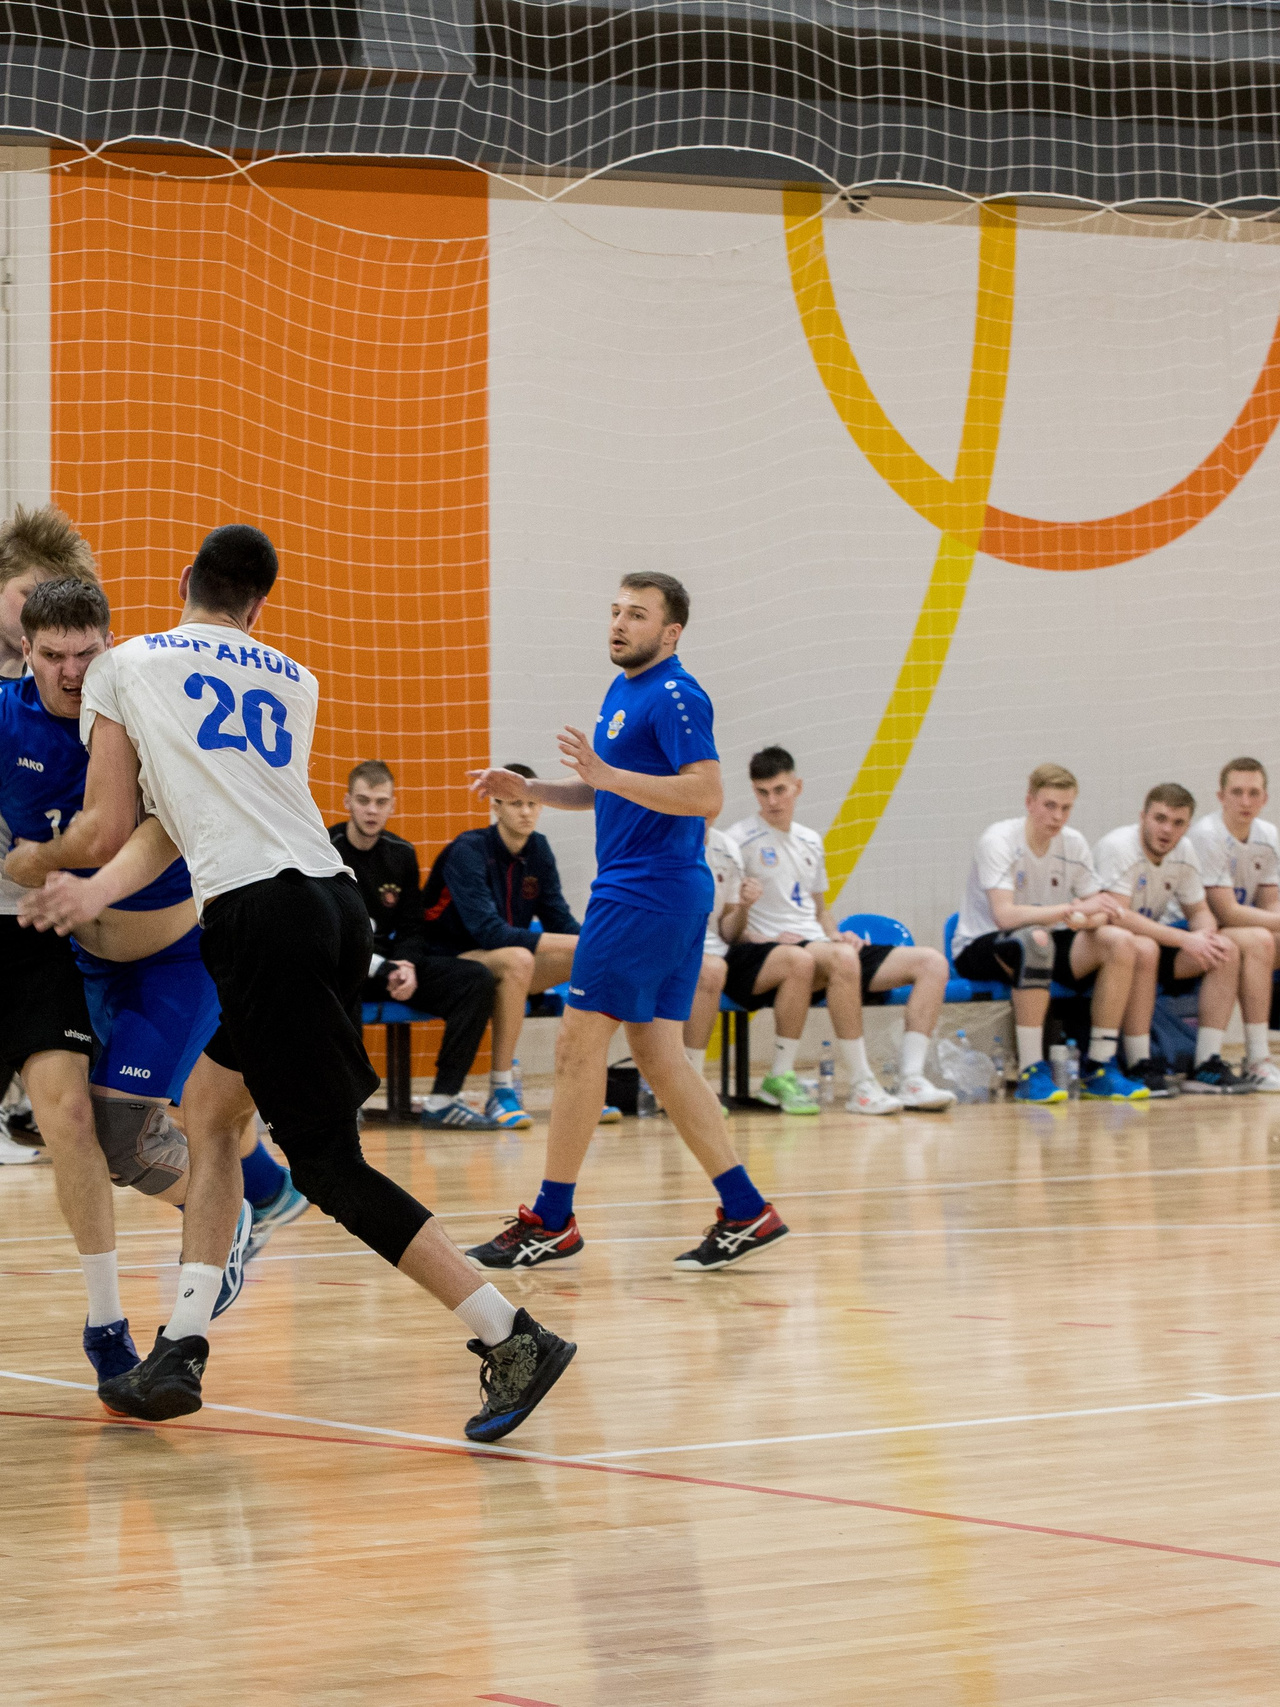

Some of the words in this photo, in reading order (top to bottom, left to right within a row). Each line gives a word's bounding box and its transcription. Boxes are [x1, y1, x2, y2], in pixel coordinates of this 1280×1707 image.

[144, 633, 301, 682] ИБРАКОВ
[184, 672, 293, 768] 20
[16, 757, 45, 773] JAKO
[790, 881, 803, 907] 4
[119, 1065, 152, 1079] JAKO
